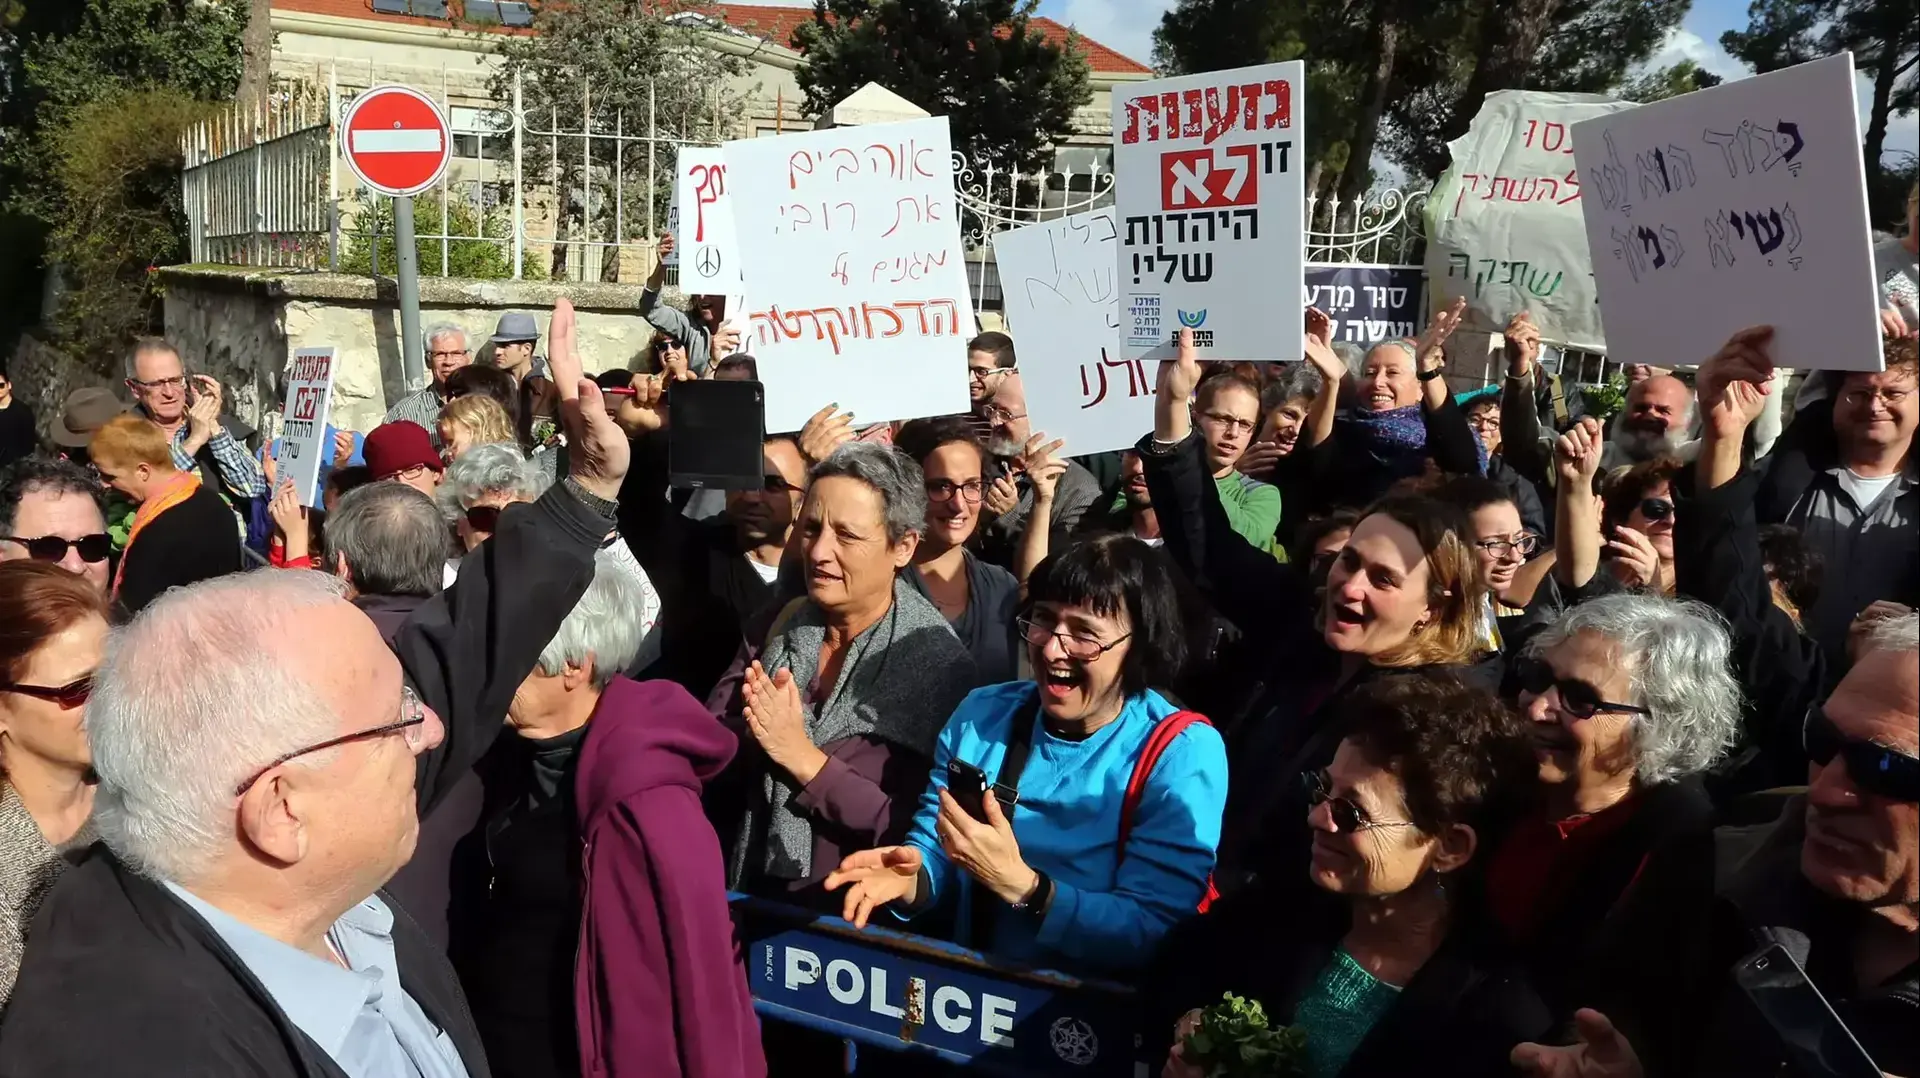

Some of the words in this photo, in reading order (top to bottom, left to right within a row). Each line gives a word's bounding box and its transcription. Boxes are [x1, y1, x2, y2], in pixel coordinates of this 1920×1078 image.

[1122, 80, 1291, 144] גזענות
[789, 139, 934, 190] אוהבים
[1170, 145, 1249, 205] לא
[1261, 141, 1292, 174] זו
[1454, 169, 1581, 219] להשתיק
[881, 194, 942, 238] את
[1125, 209, 1258, 246] היהדות
[830, 251, 849, 286] על
[872, 249, 947, 283] מגנים
[1133, 245, 1213, 284] שלי!
[1449, 252, 1563, 299] שתיקה
[1024, 267, 1119, 310] שיא
[1135, 297, 1160, 307] המרכז
[1128, 307, 1160, 317] הרפורמי
[1144, 317, 1160, 327] לדת
[1134, 327, 1160, 337] ומדינה
[1172, 340, 1214, 348] הרפות
[1081, 347, 1157, 409] ולנו
[784, 946, 1017, 1048] POLICE
